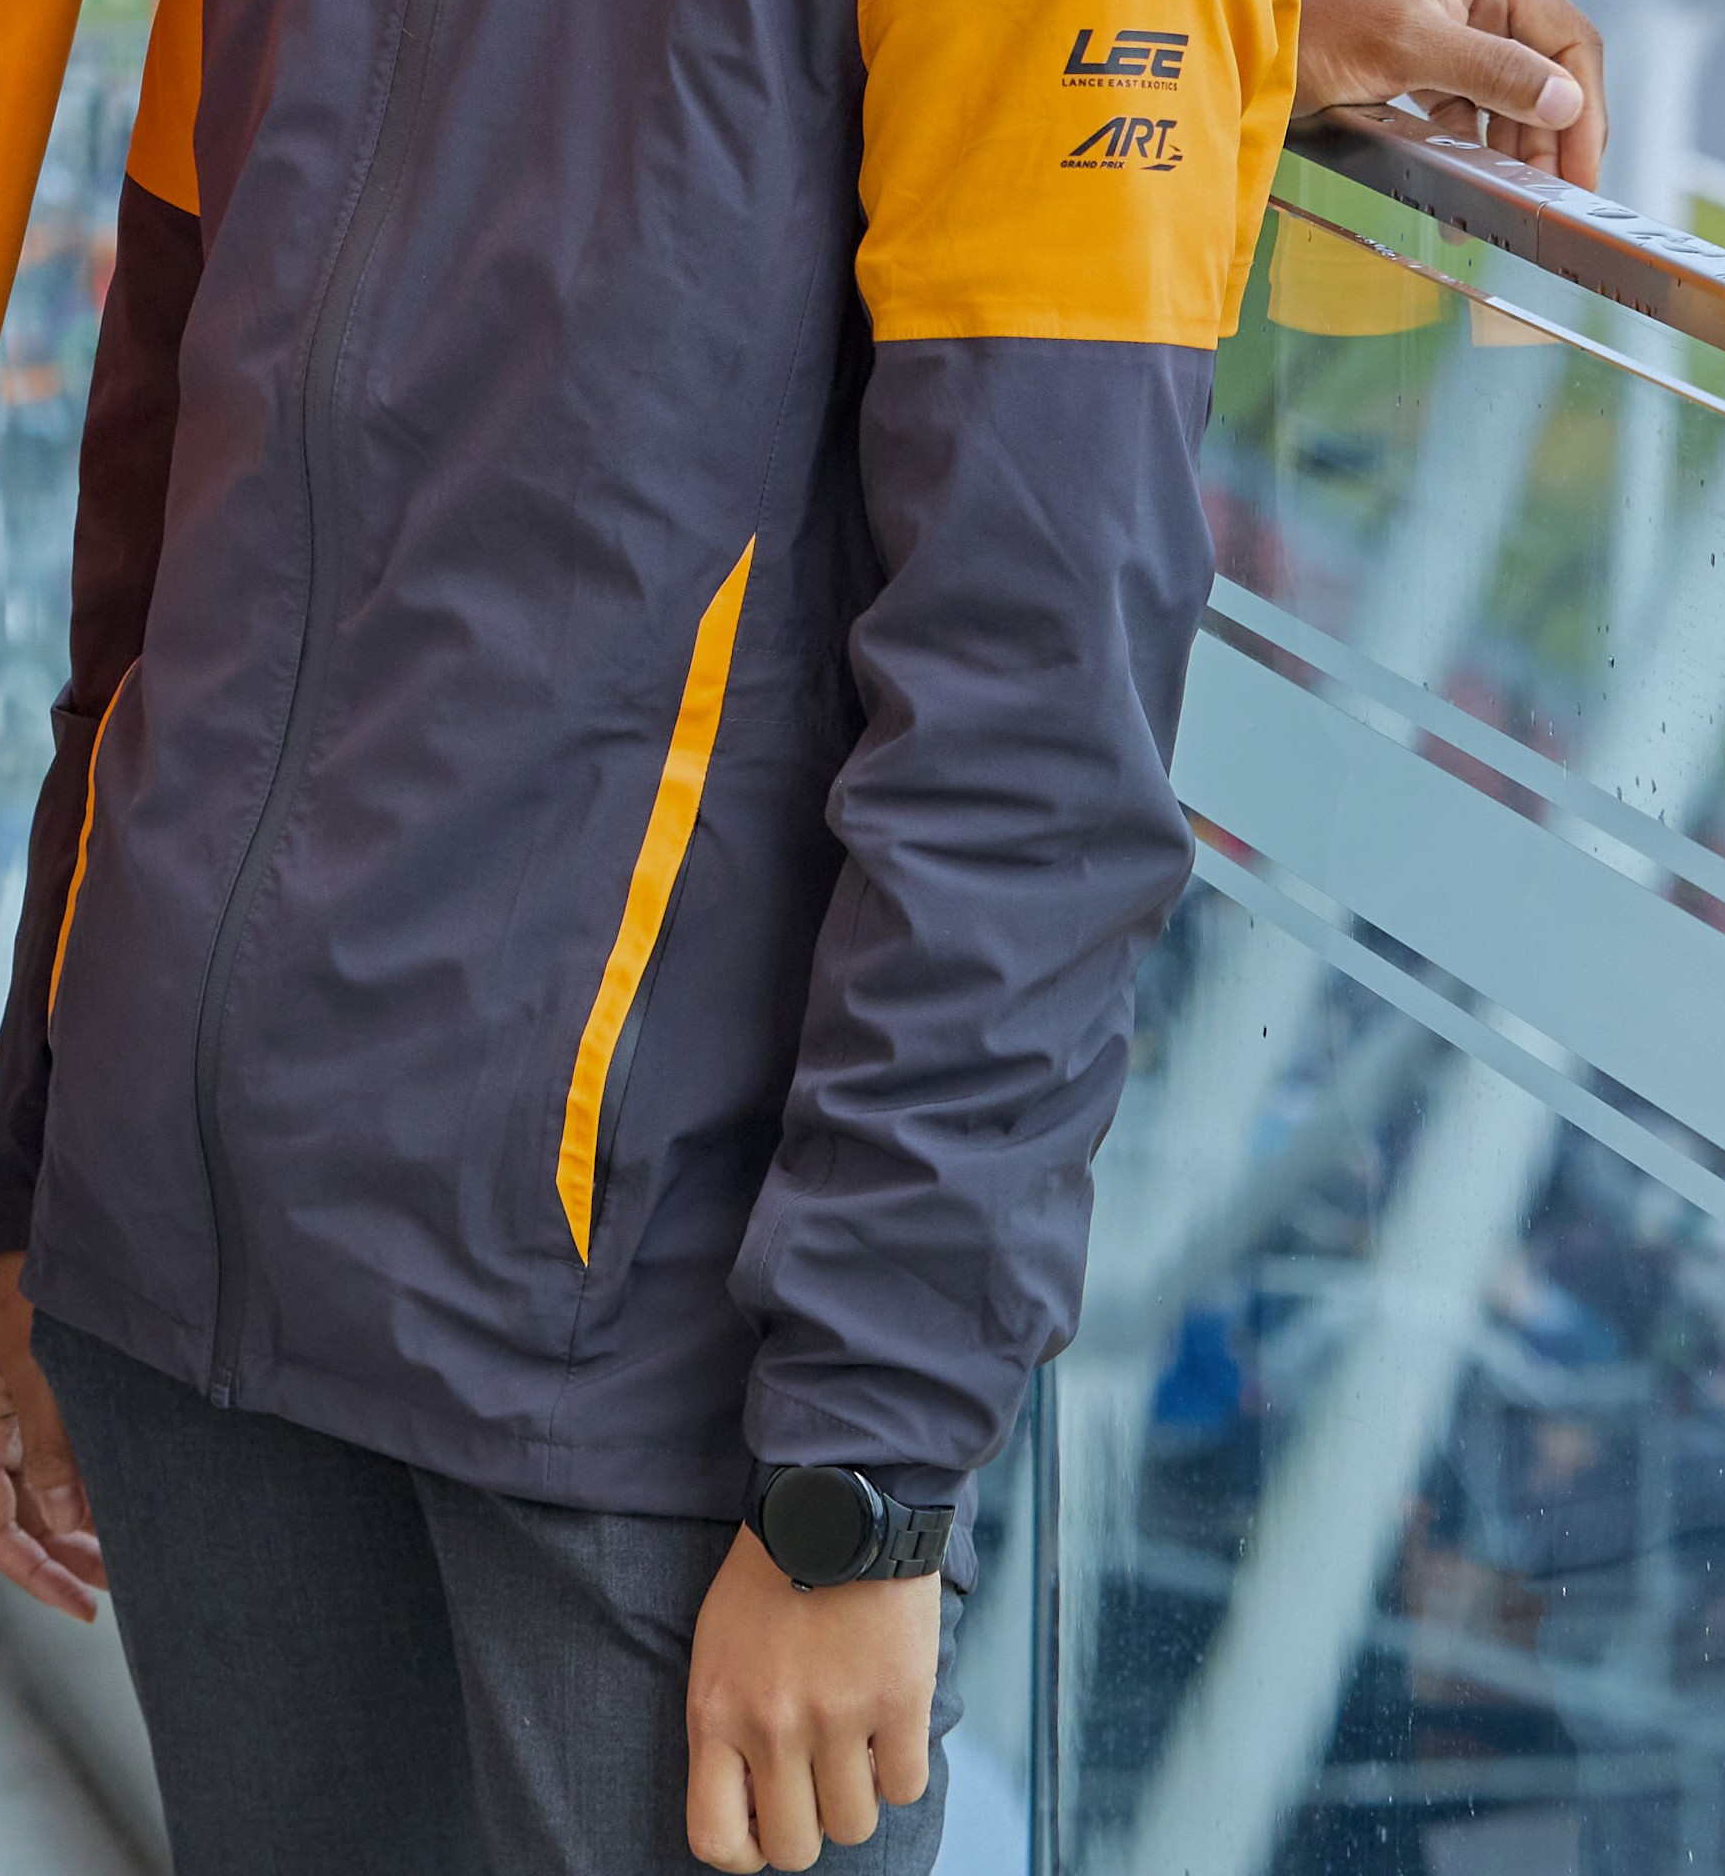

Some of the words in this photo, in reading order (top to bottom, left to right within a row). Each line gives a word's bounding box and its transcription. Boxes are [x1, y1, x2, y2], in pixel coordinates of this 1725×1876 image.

[1063, 29, 1189, 79] LEE
[1062, 78, 1104, 88] LANCE
[1108, 79, 1138, 88] EAST
[1141, 80, 1178, 91] EXOTICS
[1068, 116, 1178, 160] ART
[1060, 160, 1098, 169] GRAND
[1099, 160, 1125, 169] PRIX
